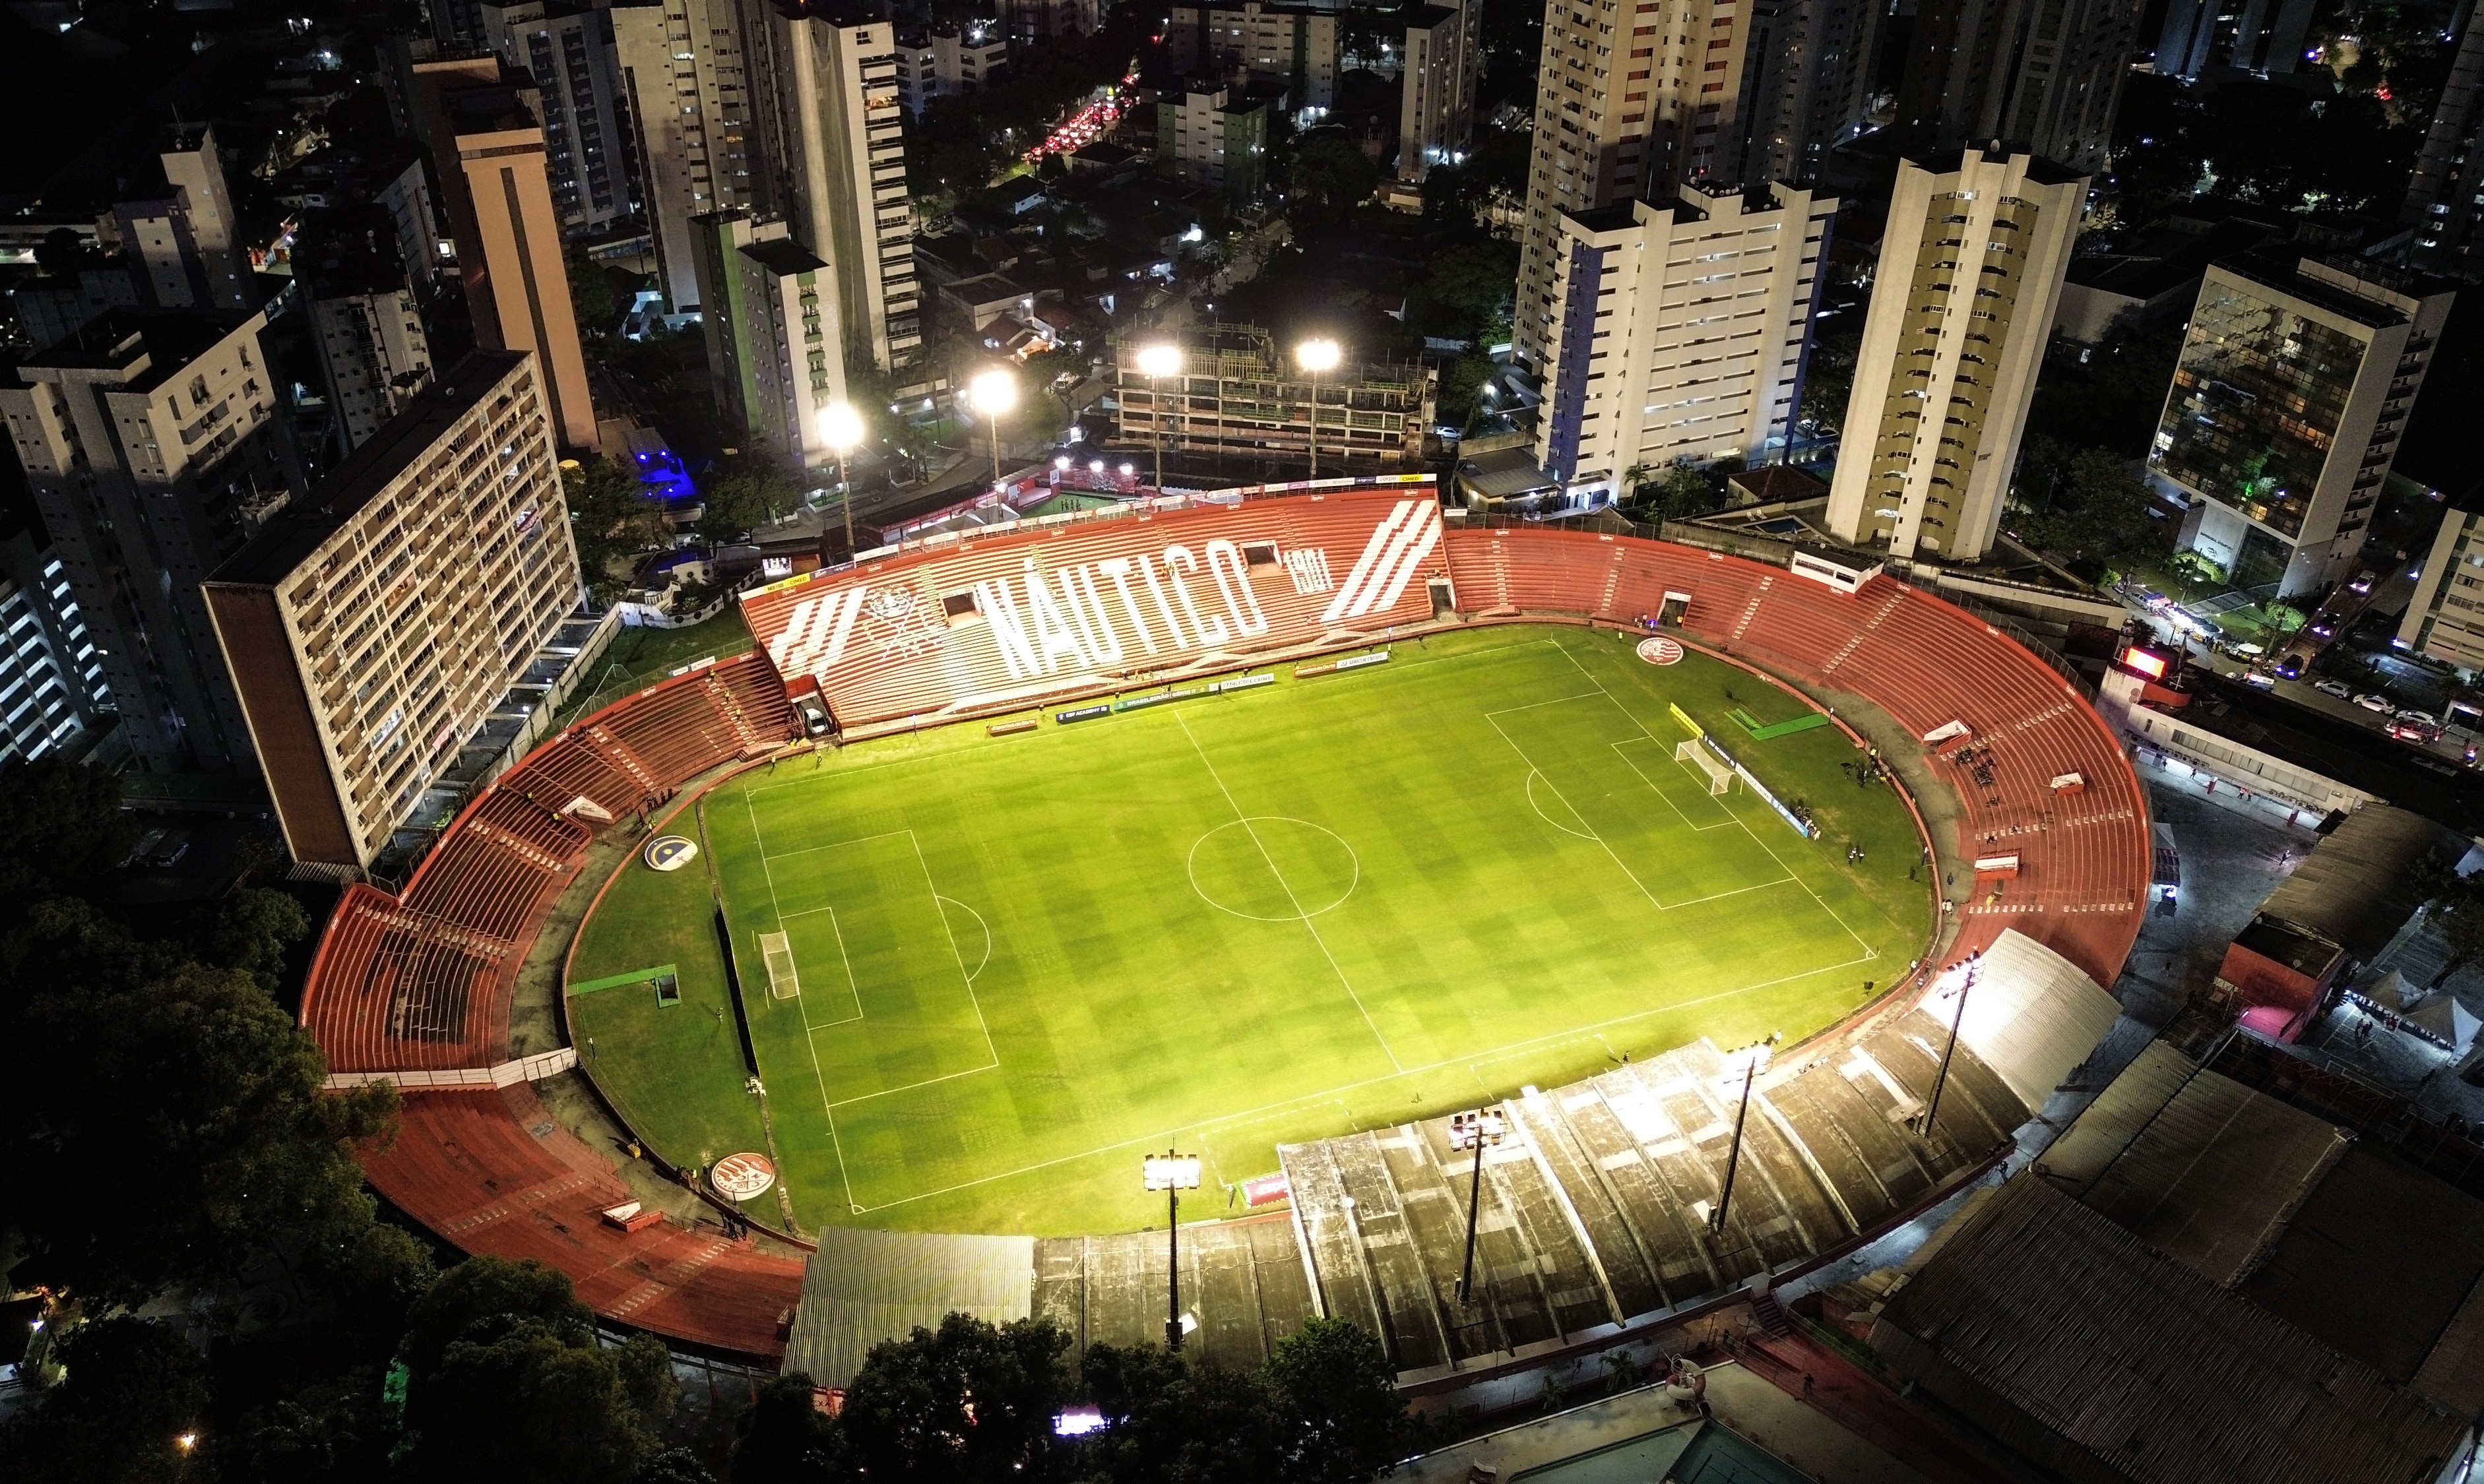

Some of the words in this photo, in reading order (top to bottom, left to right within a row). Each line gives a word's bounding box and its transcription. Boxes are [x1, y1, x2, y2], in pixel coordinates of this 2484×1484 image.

[1283, 548, 1334, 594] 1901
[1127, 693, 1170, 706] BRASILEIRÃO
[1076, 707, 1100, 717] ACADEMY
